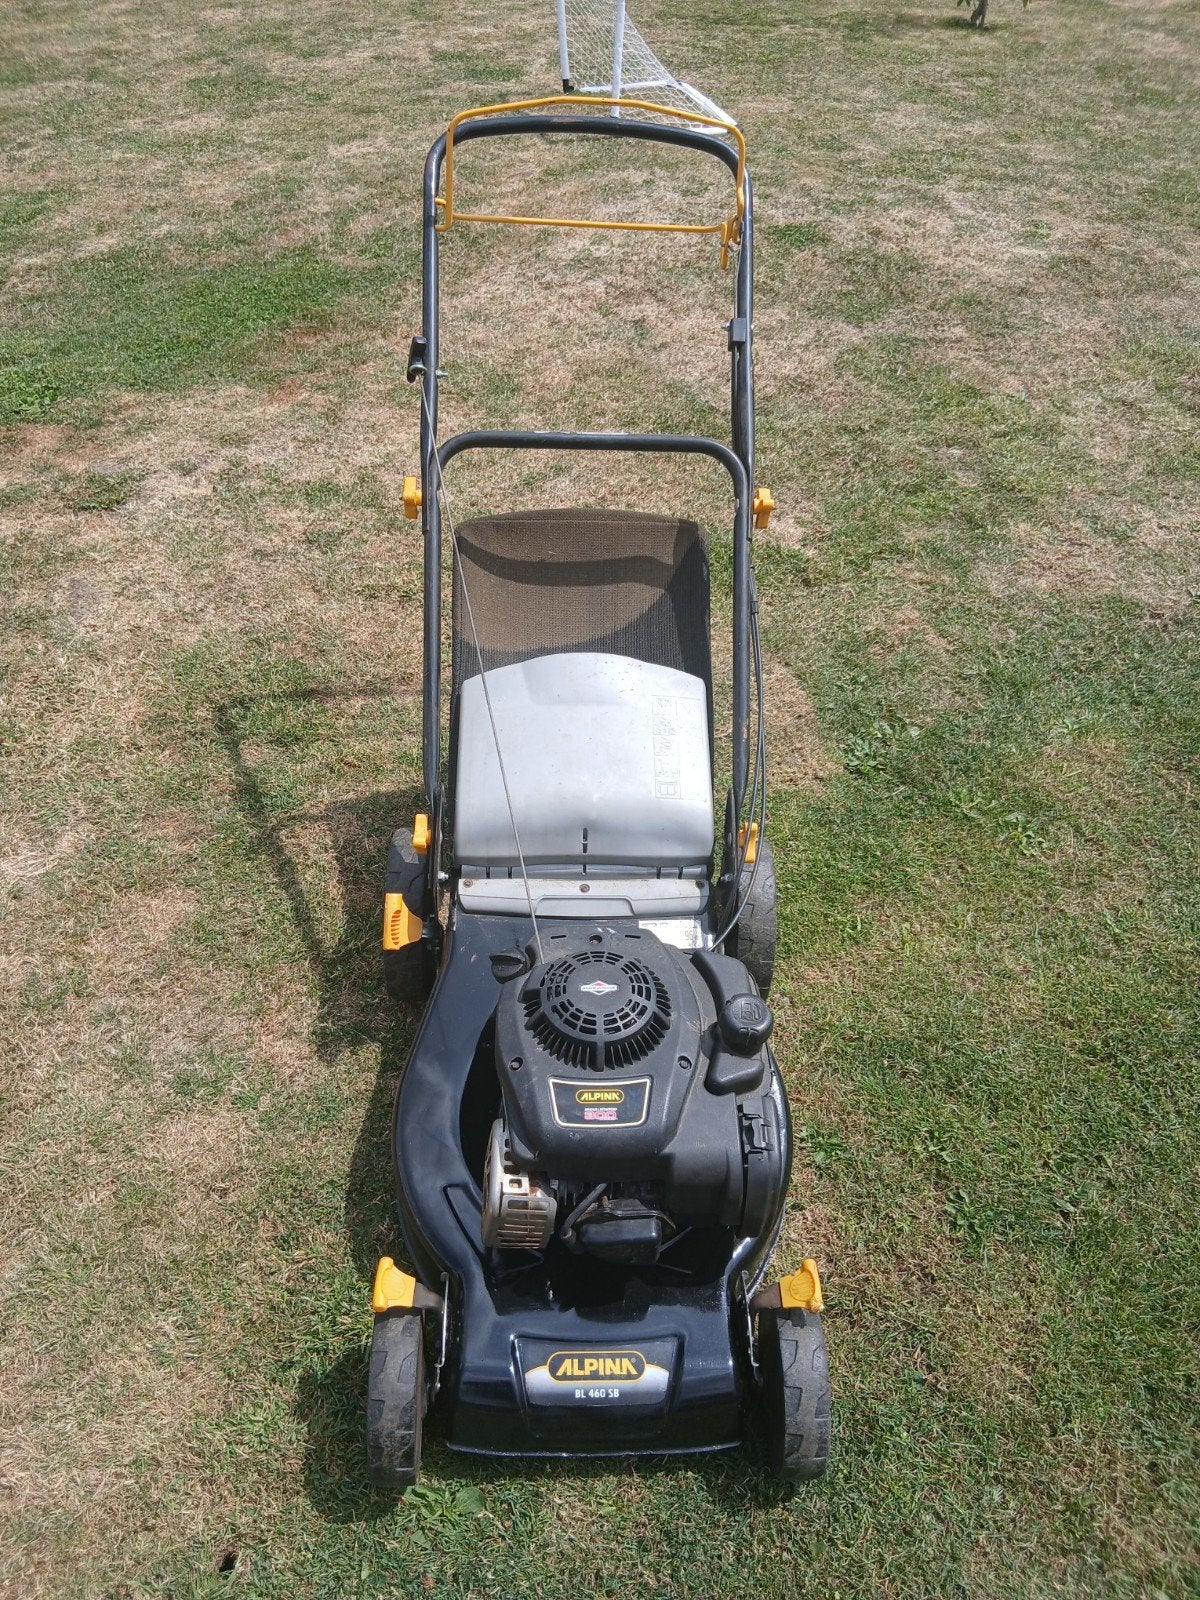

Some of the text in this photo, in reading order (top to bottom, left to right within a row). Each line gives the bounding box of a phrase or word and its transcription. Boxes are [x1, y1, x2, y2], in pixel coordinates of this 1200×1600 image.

[580, 1092, 620, 1101] ALPINA
[556, 1357, 638, 1376] ALPINA
[575, 1388, 620, 1398] BL 460 SB
